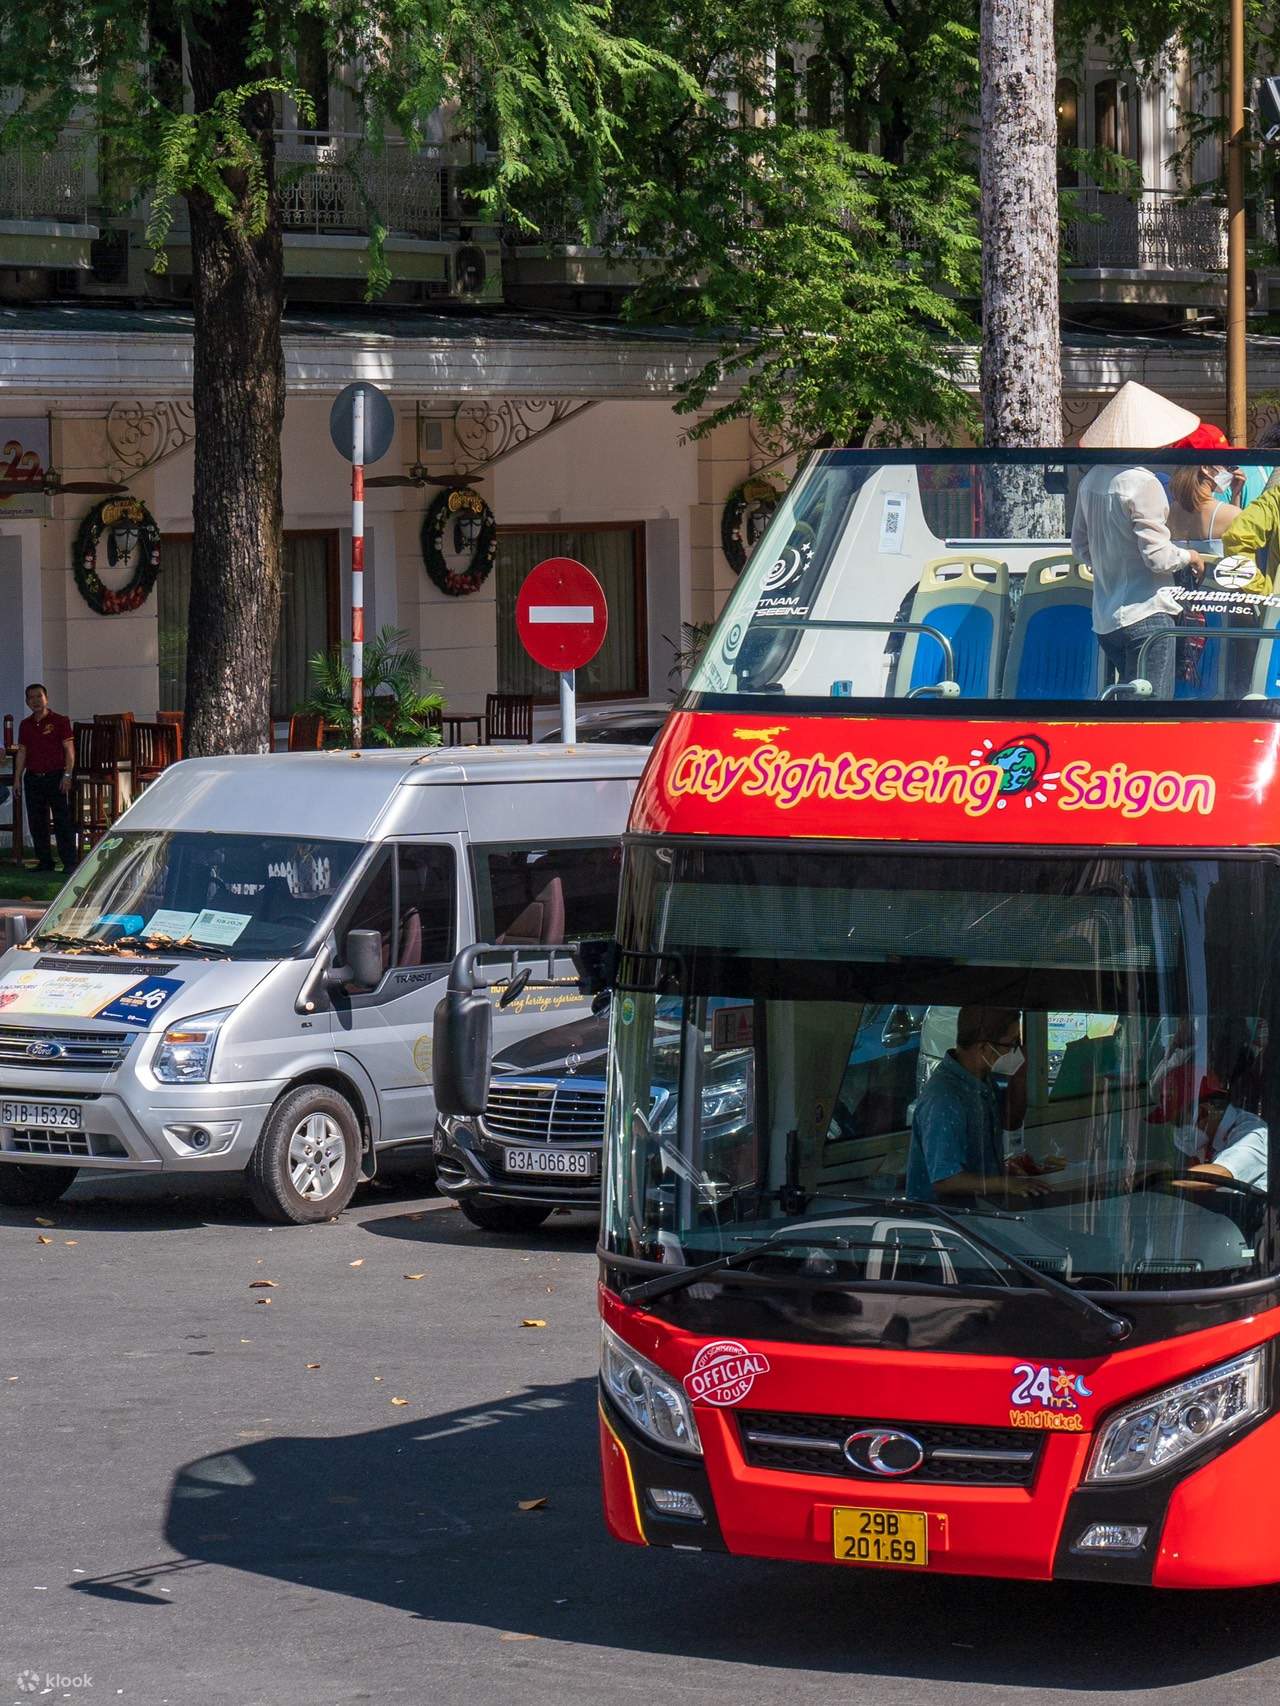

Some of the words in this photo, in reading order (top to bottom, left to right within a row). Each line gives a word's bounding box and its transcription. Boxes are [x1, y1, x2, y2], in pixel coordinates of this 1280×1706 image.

[1191, 604, 1227, 613] HANOI
[1229, 606, 1254, 615] JSC.
[668, 745, 751, 802] City
[747, 744, 1003, 817] Sightseeing
[1057, 760, 1216, 817] Saigon
[394, 972, 432, 984] TRANSIT
[32, 1043, 53, 1056] Ford
[4, 1103, 79, 1126] 51B-153.29
[508, 1151, 586, 1173] 63A-066.89
[692, 1357, 764, 1394] OFFICIAL
[1011, 1365, 1051, 1405] 24
[717, 1380, 748, 1400] TOUR
[1010, 1410, 1042, 1428] Valid
[1042, 1411, 1083, 1431] Ticket
[860, 1513, 898, 1535] 29B
[844, 1536, 916, 1561] 201.69
